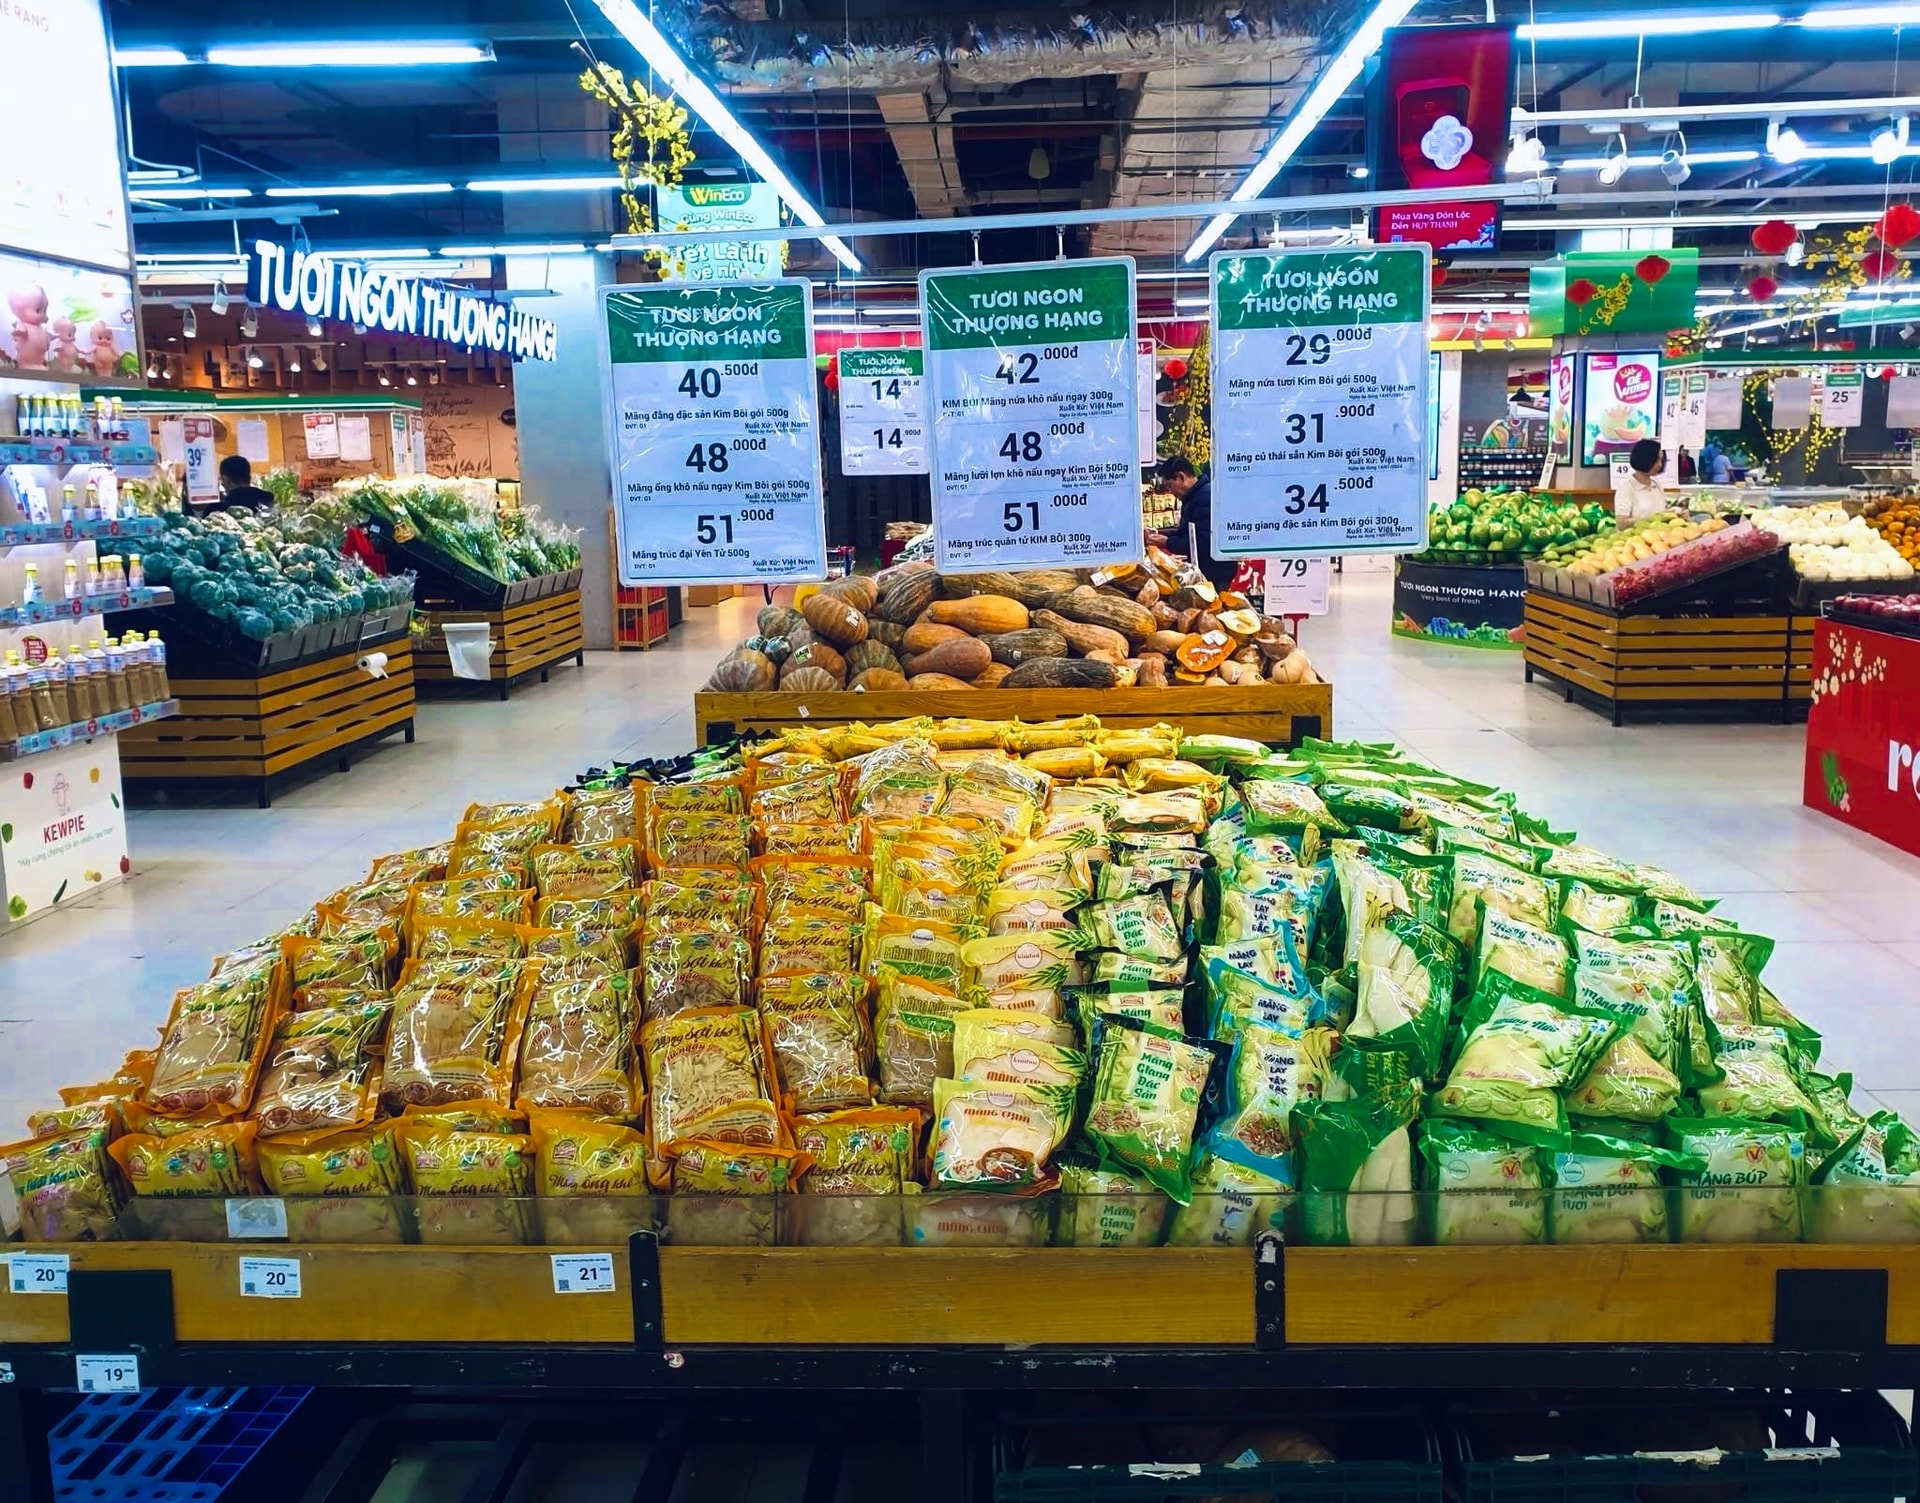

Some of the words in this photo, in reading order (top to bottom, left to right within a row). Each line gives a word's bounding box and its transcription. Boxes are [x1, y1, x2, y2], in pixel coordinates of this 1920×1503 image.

[690, 187, 744, 204] WinEco
[1413, 212, 1434, 220] Vàng
[339, 267, 418, 334] NGON
[969, 290, 1017, 309] TƯƠI
[1024, 288, 1083, 305] NGON
[952, 314, 1039, 335] THƯỢNG
[1044, 310, 1103, 332] HẠNG
[633, 331, 719, 350] THƯỢNG
[724, 328, 782, 349] HẠNG
[1286, 334, 1330, 366] 29
[996, 353, 1039, 385] 42
[1040, 345, 1078, 360] .000đ
[678, 368, 722, 399] 40
[720, 363, 758, 376] .500đ
[872, 379, 901, 400] 14
[1229, 378, 1255, 389] Măng
[1298, 376, 1316, 385] Kim
[1336, 375, 1351, 386] gói
[1353, 375, 1377, 384] 500g
[942, 399, 961, 409] KIM
[1066, 394, 1087, 404] ngay
[1090, 391, 1113, 401] 300g
[1831, 391, 1849, 403] 25
[624, 412, 650, 422] Măng
[713, 410, 731, 418] Kim
[766, 409, 789, 419] 500g
[1285, 413, 1324, 445] 31
[1335, 404, 1375, 418] .900đ
[874, 428, 903, 449] 14
[999, 432, 1042, 463] 48
[1047, 422, 1085, 436] .000đ
[188, 448, 201, 466] 39
[686, 443, 729, 473] 48
[729, 438, 767, 451] .000đ
[1227, 453, 1252, 463] Măng
[1307, 450, 1325, 459] Kim
[1362, 448, 1386, 462] 500g
[944, 472, 969, 482] Măng
[1044, 469, 1065, 479] ngay
[1068, 466, 1086, 474] Kim
[1106, 464, 1129, 473] 500g
[1616, 465, 1629, 474] 49
[627, 484, 653, 494] Măng
[711, 484, 732, 493] ngay
[735, 482, 752, 490] Kim
[787, 480, 810, 490] 500g
[1284, 484, 1329, 515] 34
[1334, 475, 1374, 490] .500đ
[1003, 501, 1040, 532] 51
[1050, 493, 1088, 508] .000đ
[697, 515, 733, 544] 51
[737, 508, 774, 522] .900đ
[1227, 522, 1252, 532] Măng
[1255, 521, 1280, 531] giang
[1320, 518, 1338, 527] Kim
[1375, 516, 1399, 526] 300g
[948, 539, 973, 549] Măng
[1030, 536, 1048, 544] KIM
[1068, 533, 1091, 544] 300g
[632, 550, 657, 560] Măng
[727, 549, 750, 559] 500g
[1280, 559, 1308, 578] 79
[1415, 584, 1439, 593] NGON
[1441, 586, 1484, 597] THƯỢNG
[1421, 594, 1434, 602] Very
[1461, 597, 1481, 605] fresh
[43, 815, 85, 844] KEWPIE
[1736, 1169, 1768, 1184] BÚP
[35, 1269, 55, 1282] 20
[266, 1271, 286, 1286] 20
[579, 1267, 598, 1281] 21
[105, 1368, 123, 1381] 19
